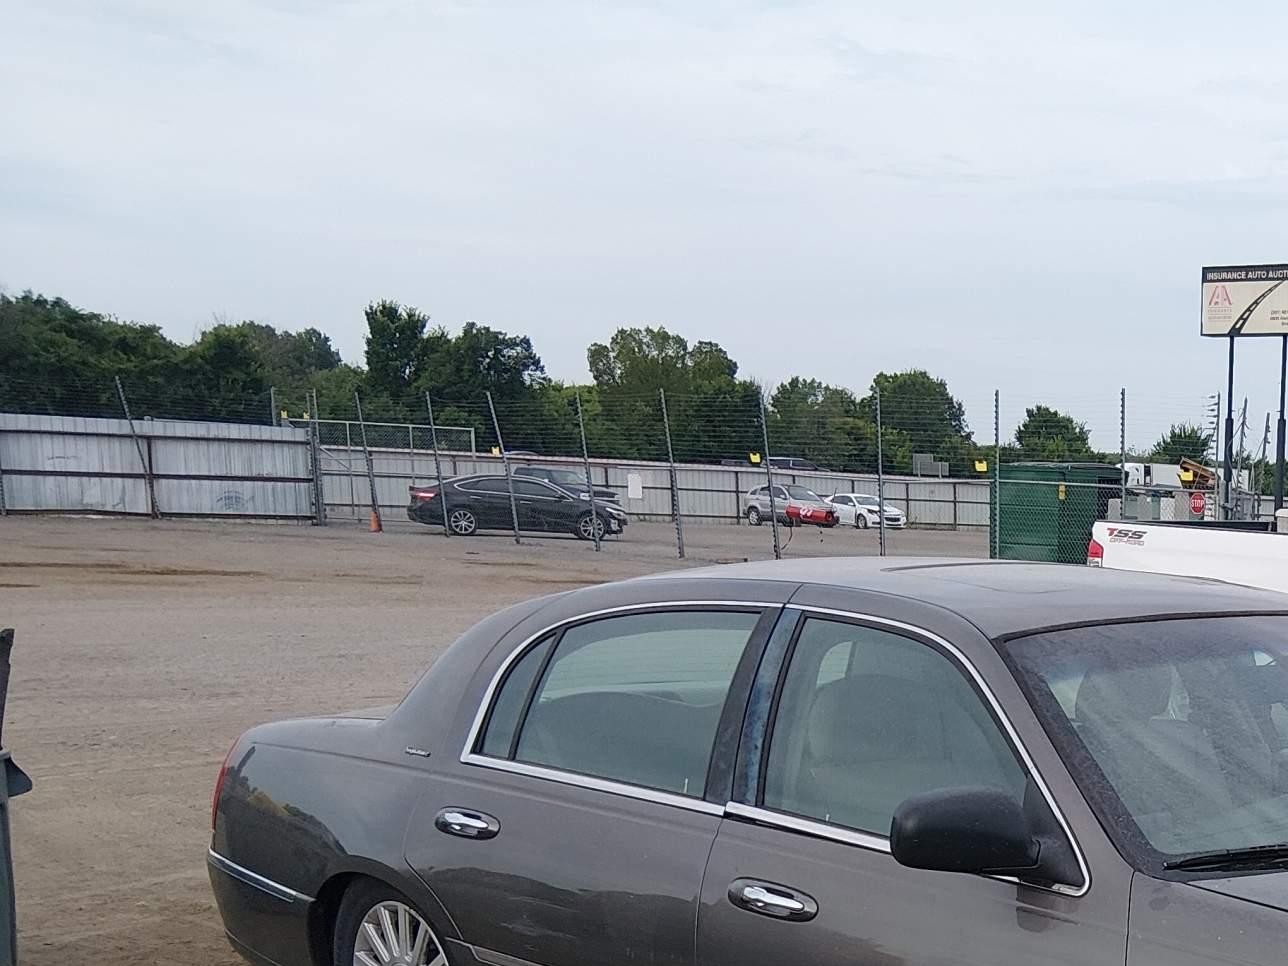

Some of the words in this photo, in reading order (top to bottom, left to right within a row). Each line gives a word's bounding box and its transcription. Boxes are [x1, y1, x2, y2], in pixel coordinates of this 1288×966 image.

[1207, 271, 1246, 280] INSURANCE
[1247, 271, 1267, 279] AUTO
[1191, 499, 1204, 508] STOP
[1107, 528, 1148, 539] TSS
